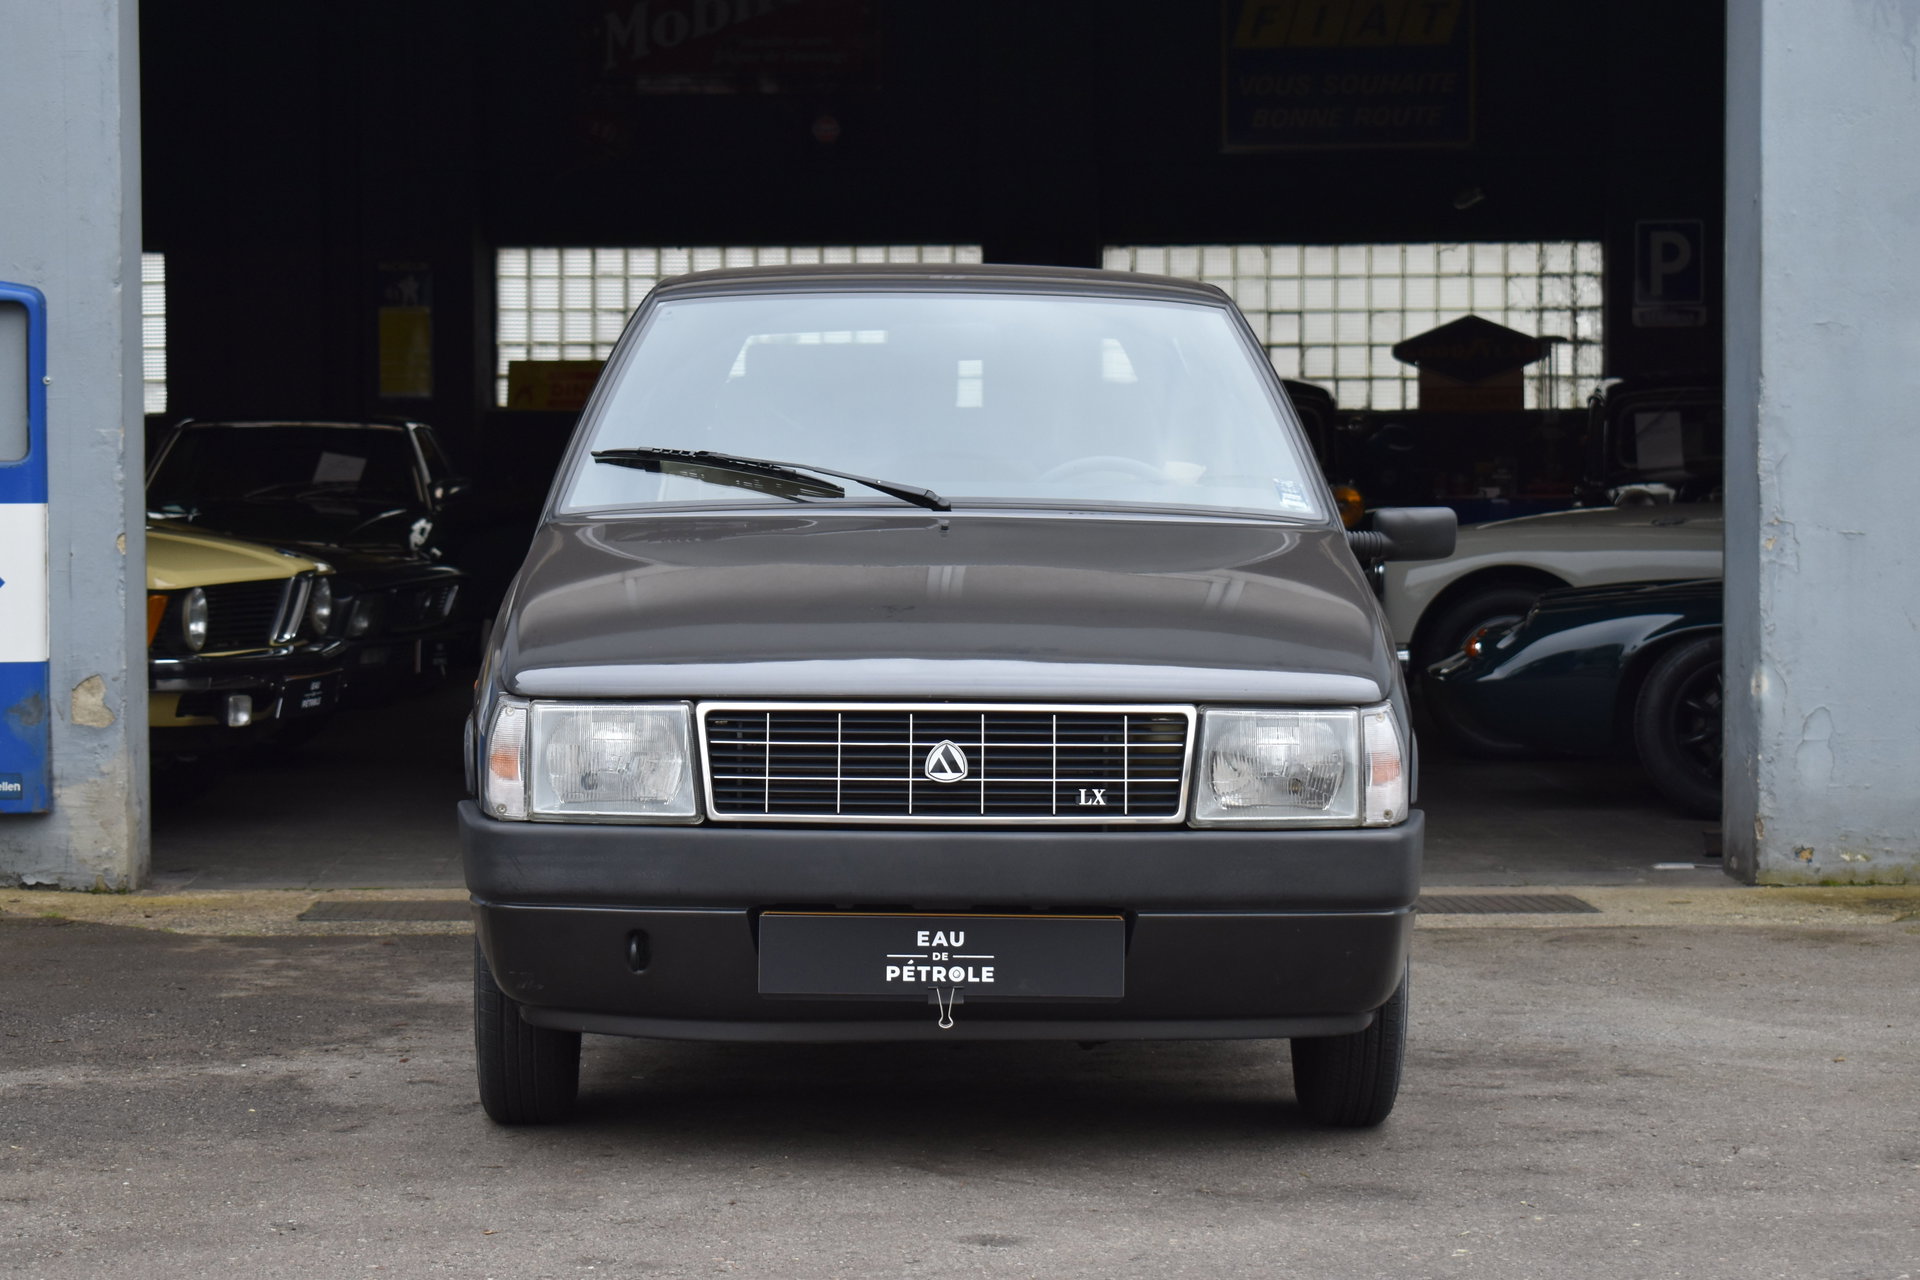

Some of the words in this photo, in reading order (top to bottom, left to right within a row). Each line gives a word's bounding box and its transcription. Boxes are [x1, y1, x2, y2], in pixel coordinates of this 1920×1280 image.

[1251, 2, 1451, 39] FIAT
[1239, 75, 1312, 97] VOUS
[1321, 72, 1459, 96] SOUHAITE
[1252, 107, 1345, 129] BONNE
[1353, 105, 1445, 128] ROUTE
[1650, 231, 1692, 297] P
[1079, 788, 1107, 806] LX
[917, 931, 965, 947] EAU
[932, 952, 949, 961] DE
[886, 959, 995, 983] PÉTROLE
